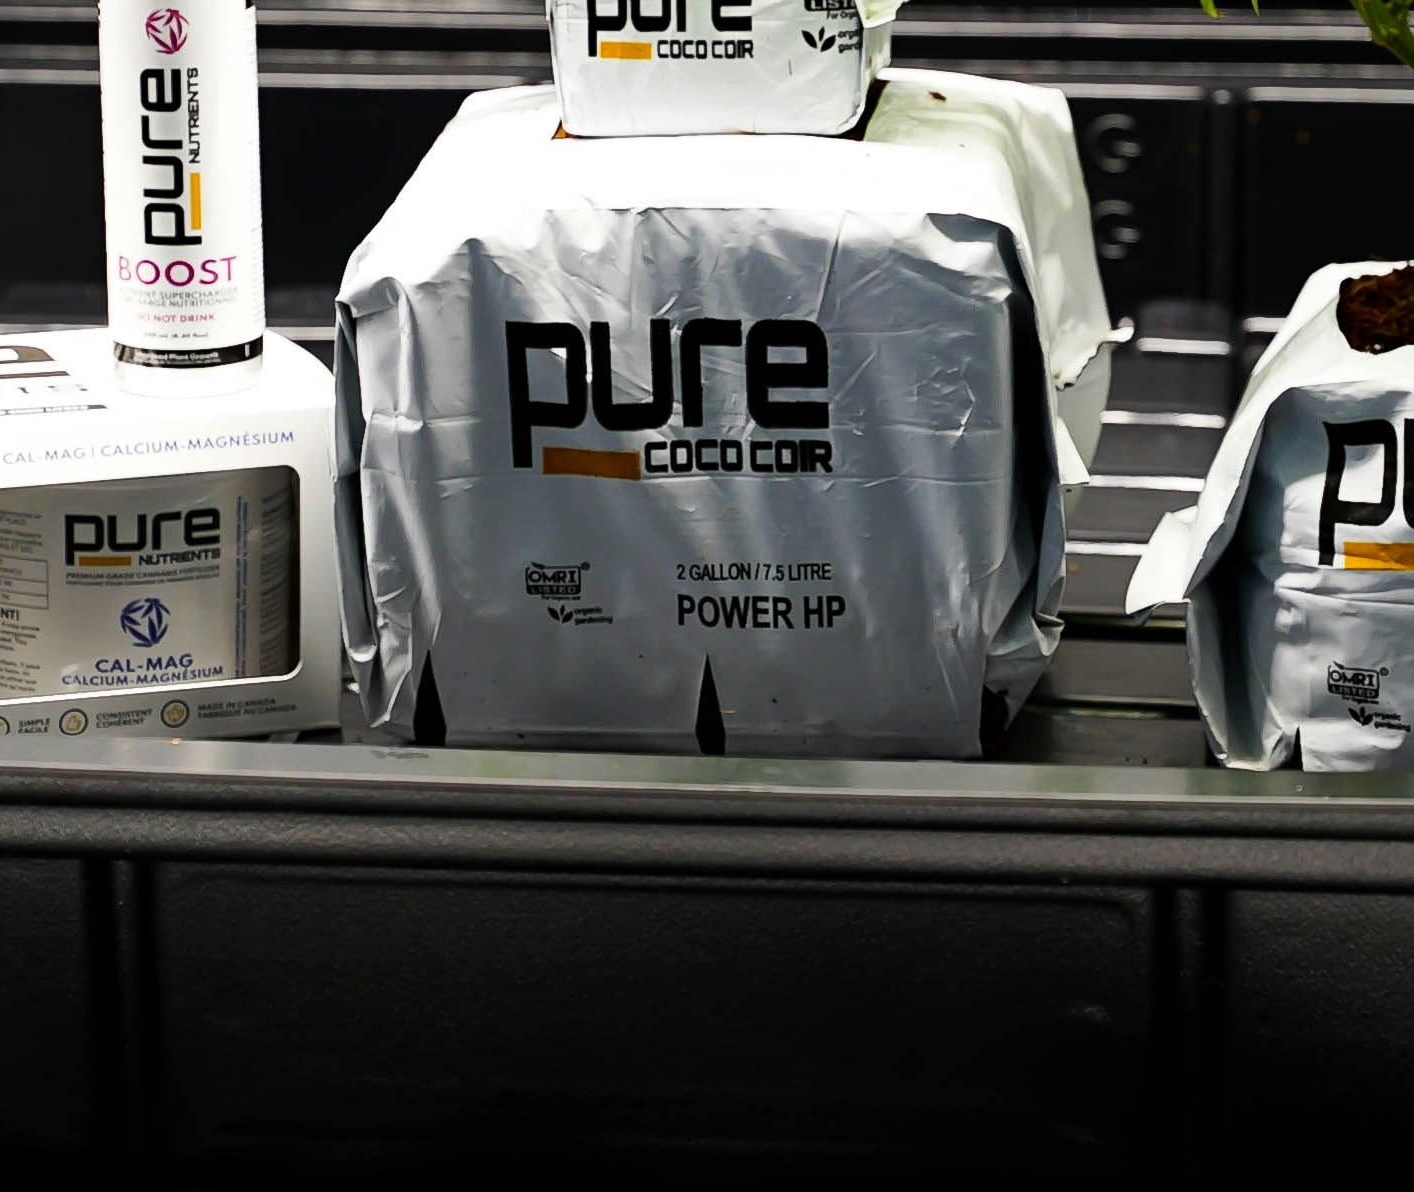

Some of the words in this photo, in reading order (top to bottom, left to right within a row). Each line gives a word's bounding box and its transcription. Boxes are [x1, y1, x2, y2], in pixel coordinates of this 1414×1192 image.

[657, 39, 707, 59] COCO
[712, 39, 754, 59] COIR
[187, 67, 201, 164] NUTRIENTS
[140, 68, 202, 246] pure
[118, 255, 237, 287] BOOST
[153, 314, 175, 322] NOT
[179, 313, 216, 323] DRINK
[505, 317, 830, 468] pure
[3, 447, 87, 465] CAL-MAG
[100, 430, 295, 457] CALCIUM-MAGNÉSIUM
[644, 439, 743, 474] COCO
[749, 439, 834, 474] COIR
[65, 508, 220, 566] pure
[138, 548, 221, 566] NUTRIENTS
[528, 570, 576, 583] OMRI
[676, 563, 686, 581] 2
[689, 563, 751, 581] GALLON
[762, 563, 785, 582] 7.5
[788, 563, 832, 582] LITRE
[677, 594, 795, 630] POWER
[803, 595, 847, 629] HP
[95, 653, 194, 673] CAL-MAG
[62, 665, 224, 686] CALCIUM-MAGNÉSIUM
[1330, 670, 1375, 687] OMRI
[18, 718, 51, 727] SIMPLE
